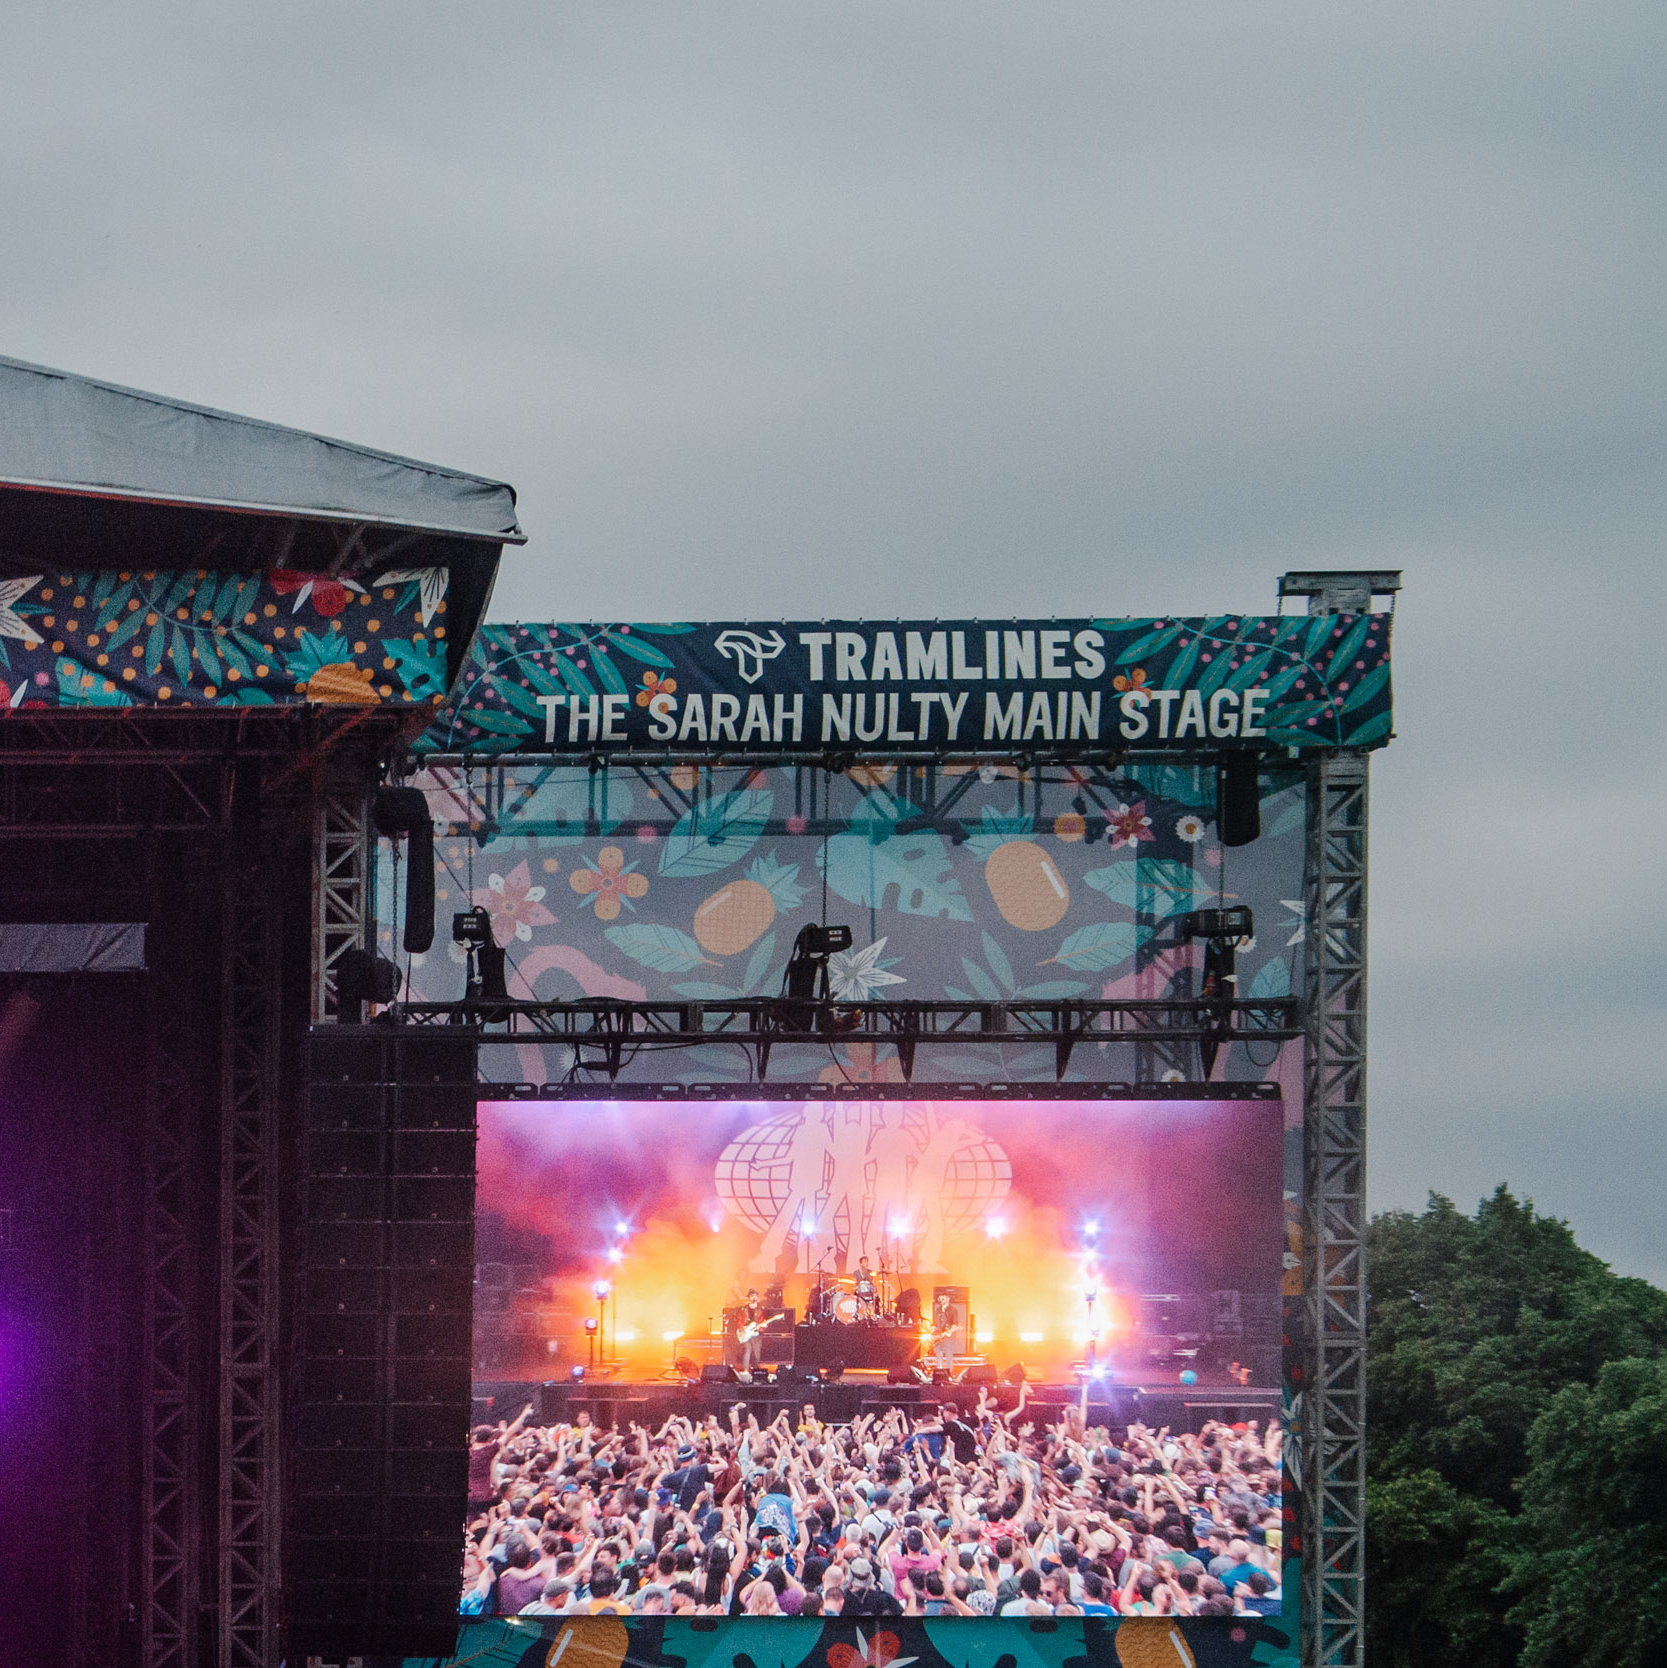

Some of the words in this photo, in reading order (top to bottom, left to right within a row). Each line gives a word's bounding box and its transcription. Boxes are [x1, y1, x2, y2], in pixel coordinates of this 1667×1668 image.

[799, 629, 1106, 681] TRAMLINES
[536, 693, 629, 743] THE
[648, 692, 804, 742] SARAH
[821, 692, 969, 742] NULTY
[983, 691, 1101, 740] MAIN
[1120, 688, 1270, 740] STAGE
